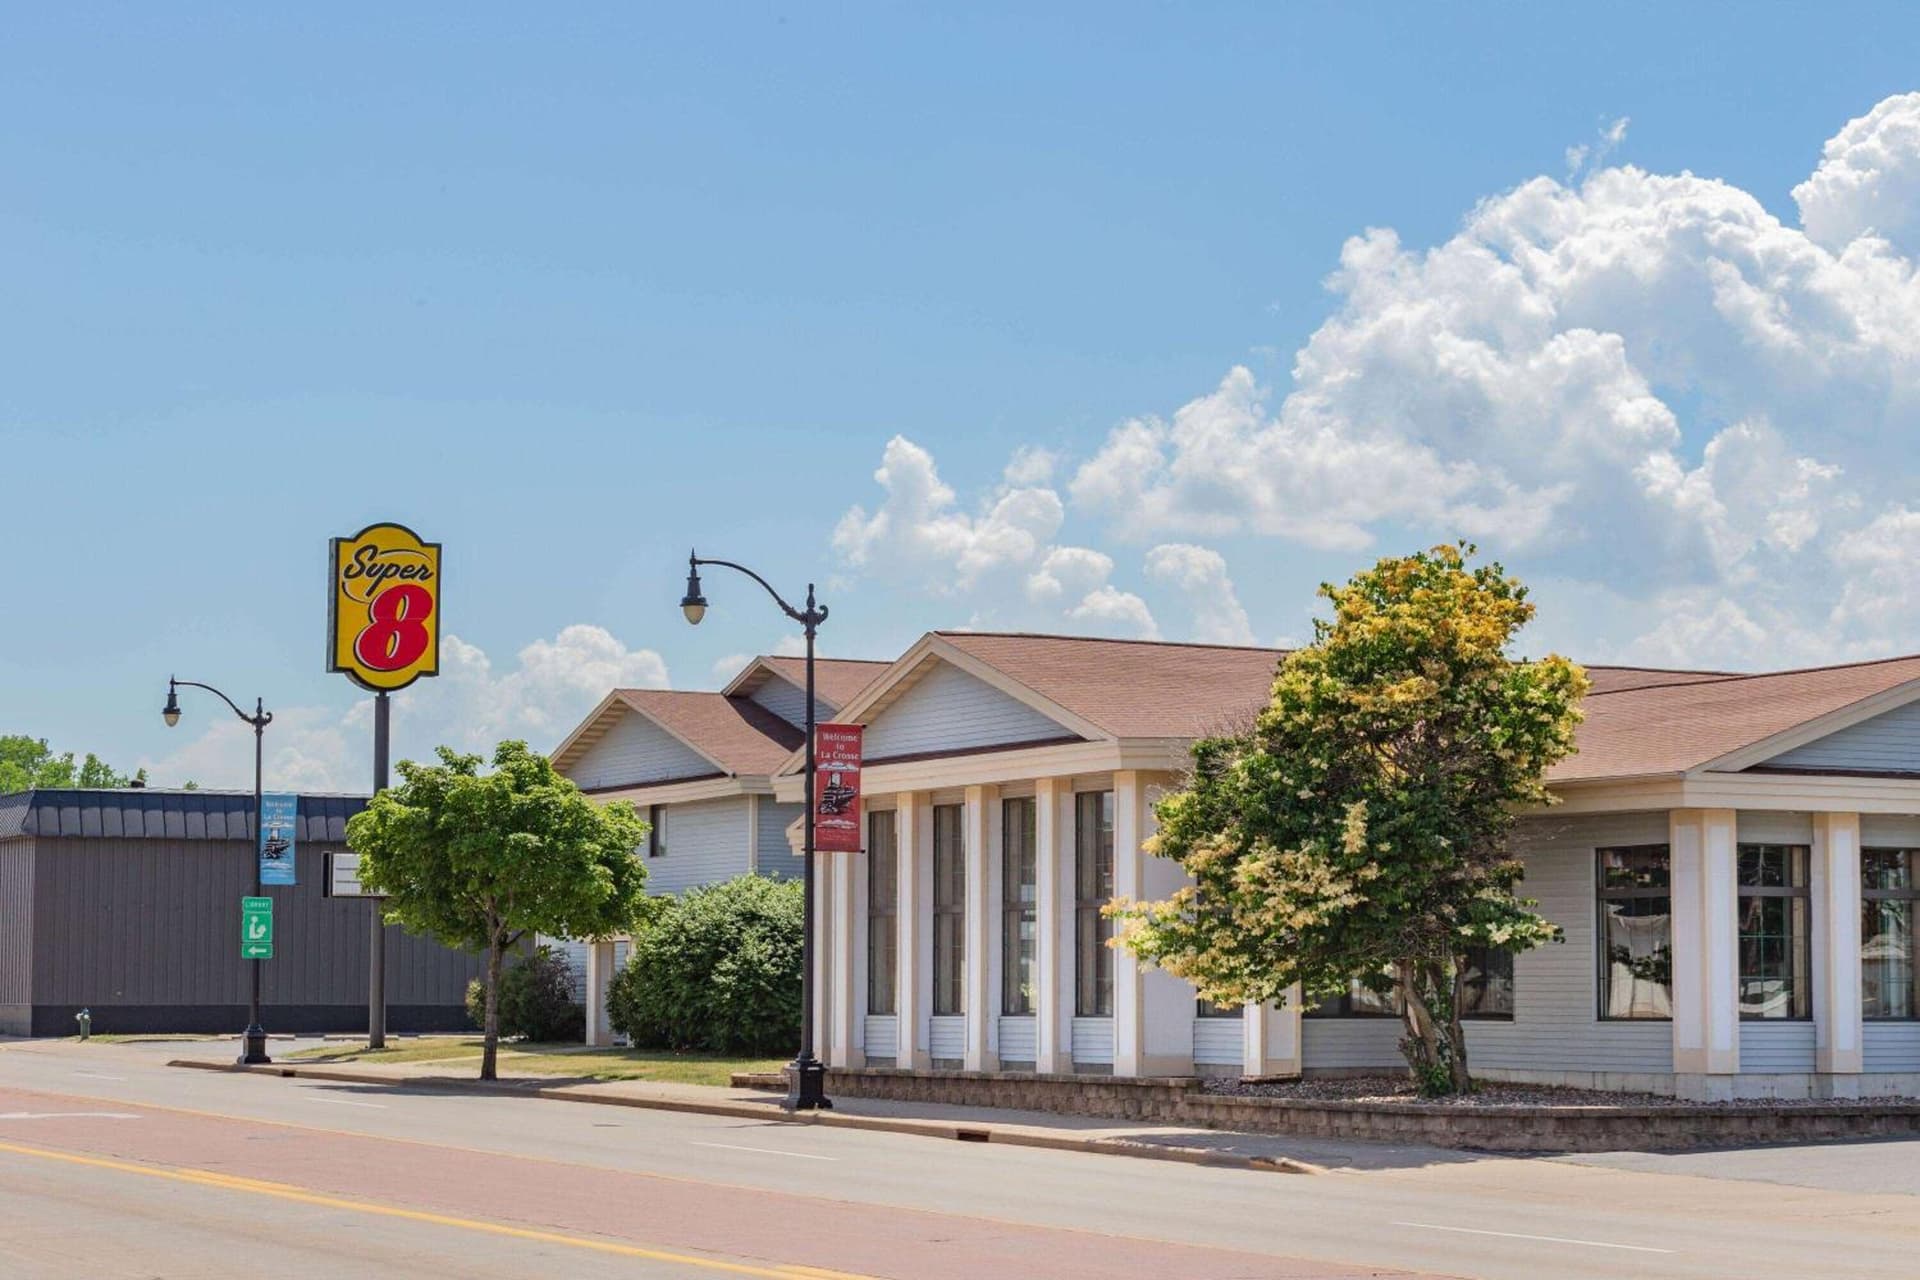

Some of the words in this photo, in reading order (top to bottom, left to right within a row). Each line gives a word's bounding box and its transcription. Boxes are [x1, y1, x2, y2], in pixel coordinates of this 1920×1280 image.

[343, 544, 434, 597] Super
[353, 583, 434, 672] 8
[822, 732, 858, 742] Welcome
[836, 743, 845, 751] to
[821, 751, 831, 759] La
[832, 751, 860, 760] Crosse
